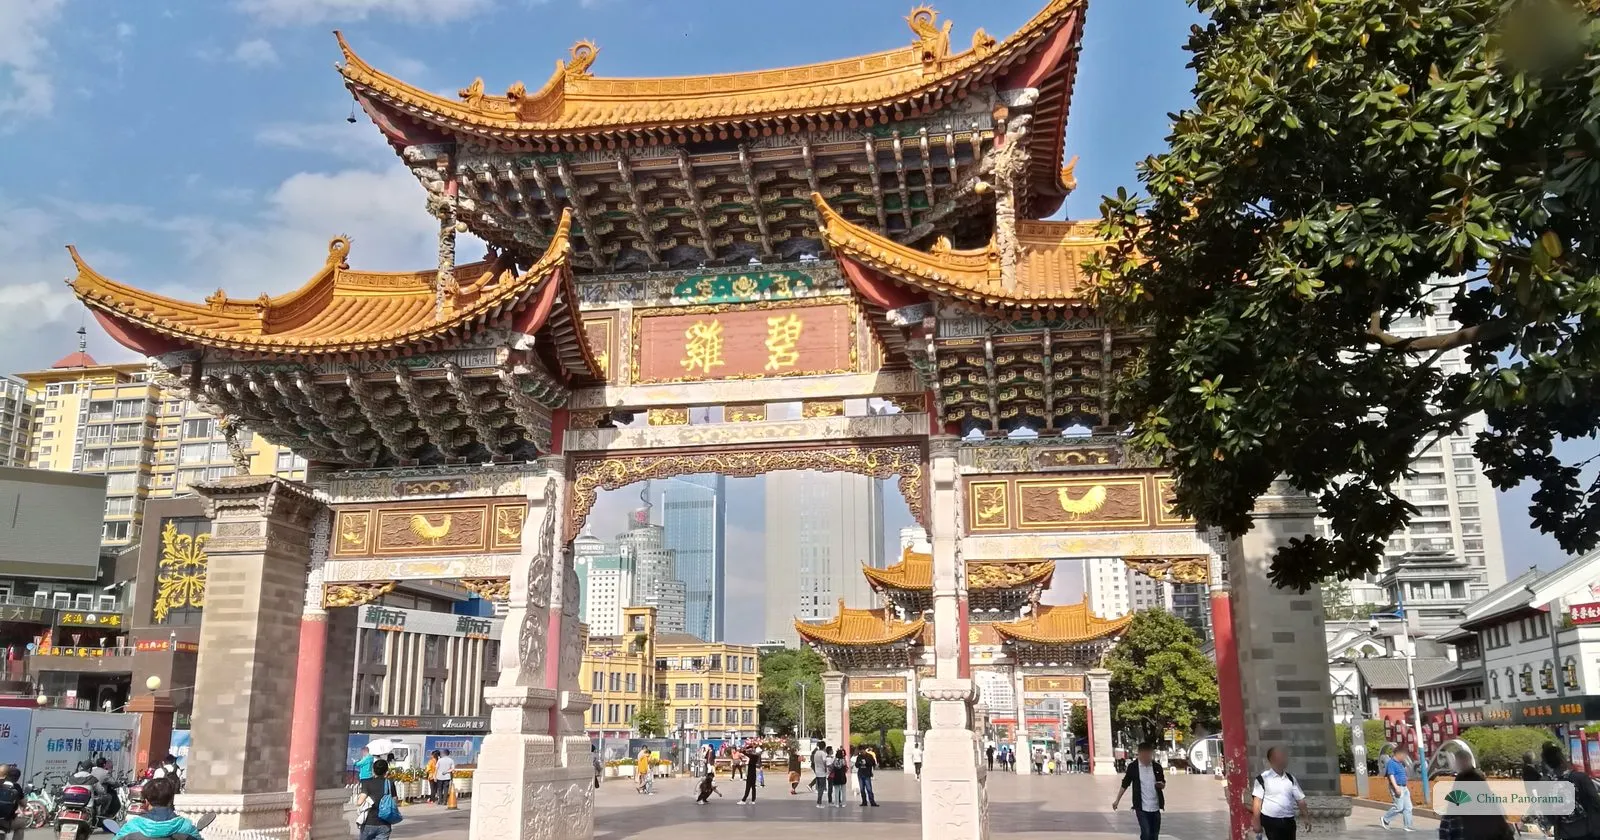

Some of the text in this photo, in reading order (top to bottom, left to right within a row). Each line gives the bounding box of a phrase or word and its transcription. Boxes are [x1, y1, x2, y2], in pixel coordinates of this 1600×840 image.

[365, 605, 407, 629] 新东方
[456, 616, 492, 637] 新东方
